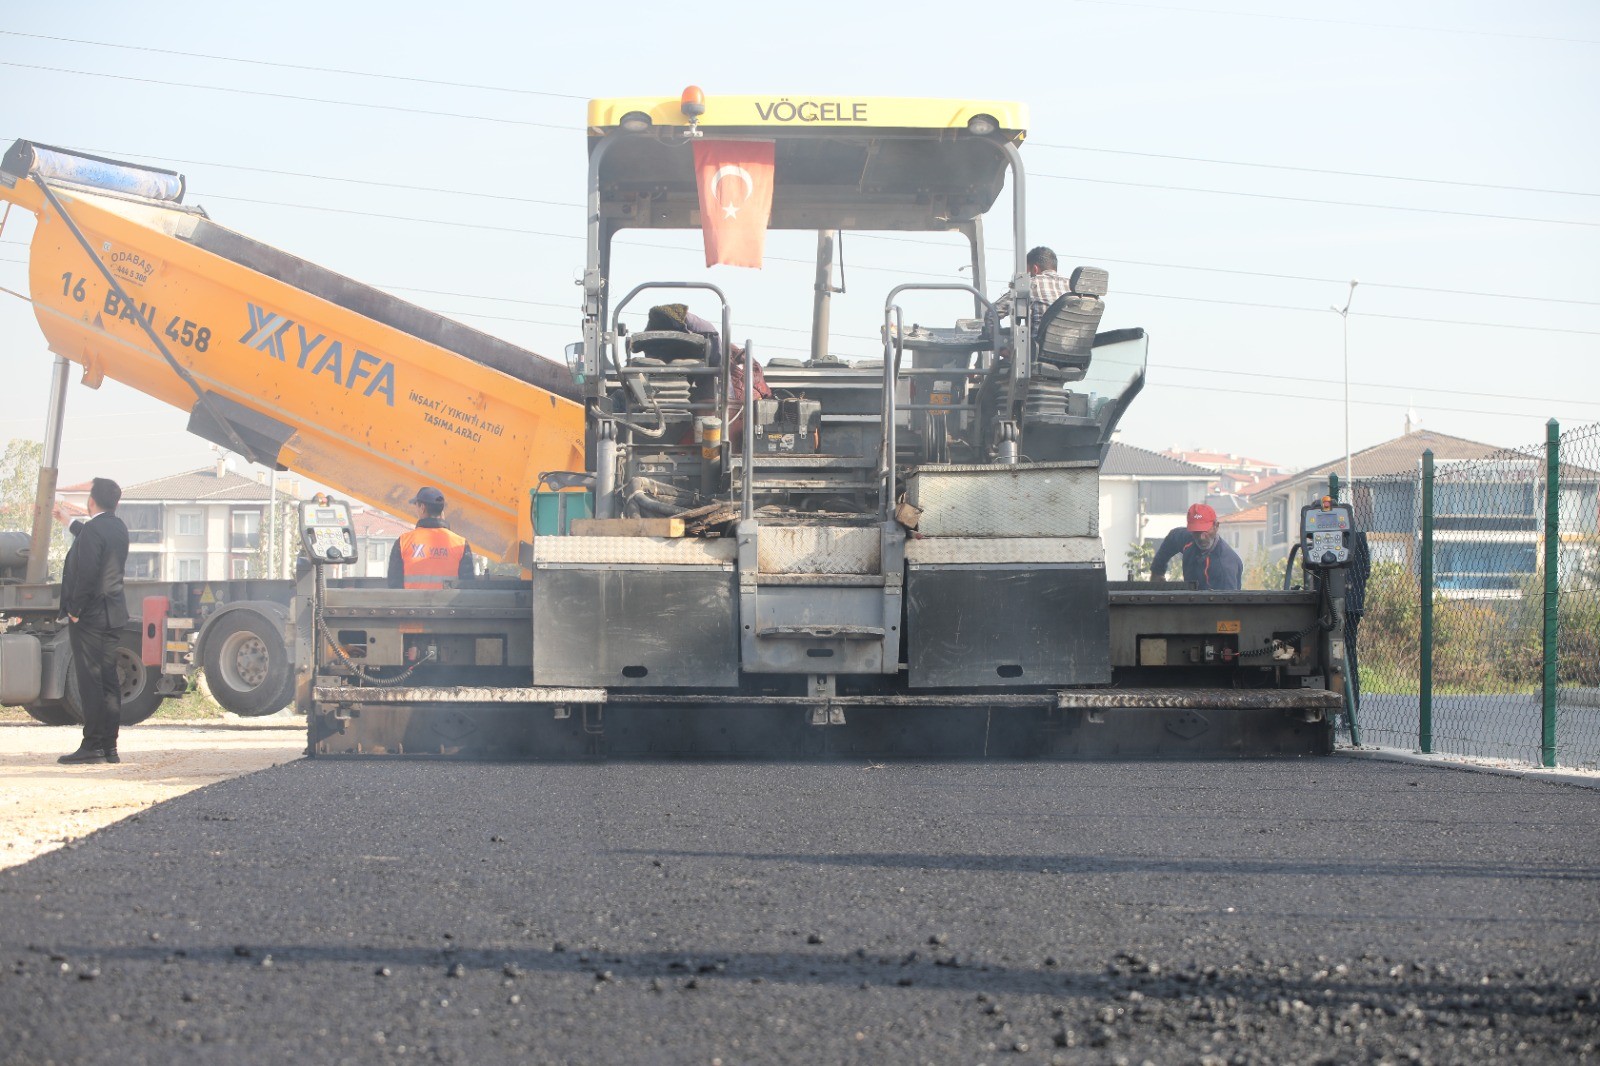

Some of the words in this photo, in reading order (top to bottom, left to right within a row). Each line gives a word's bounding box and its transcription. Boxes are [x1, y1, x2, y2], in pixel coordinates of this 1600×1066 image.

[755, 98, 867, 121] VÖGELE
[111, 252, 154, 275] ODABAŞI
[117, 265, 129, 276] 444
[61, 272, 86, 302] 16
[103, 289, 156, 328] BAU
[165, 316, 211, 352] 458
[297, 324, 394, 407] YAFA
[408, 389, 440, 411] İNŞAAT
[423, 412, 453, 432] TAŞIMA
[454, 426, 482, 443] ARACI
[429, 547, 449, 558] YAFA
